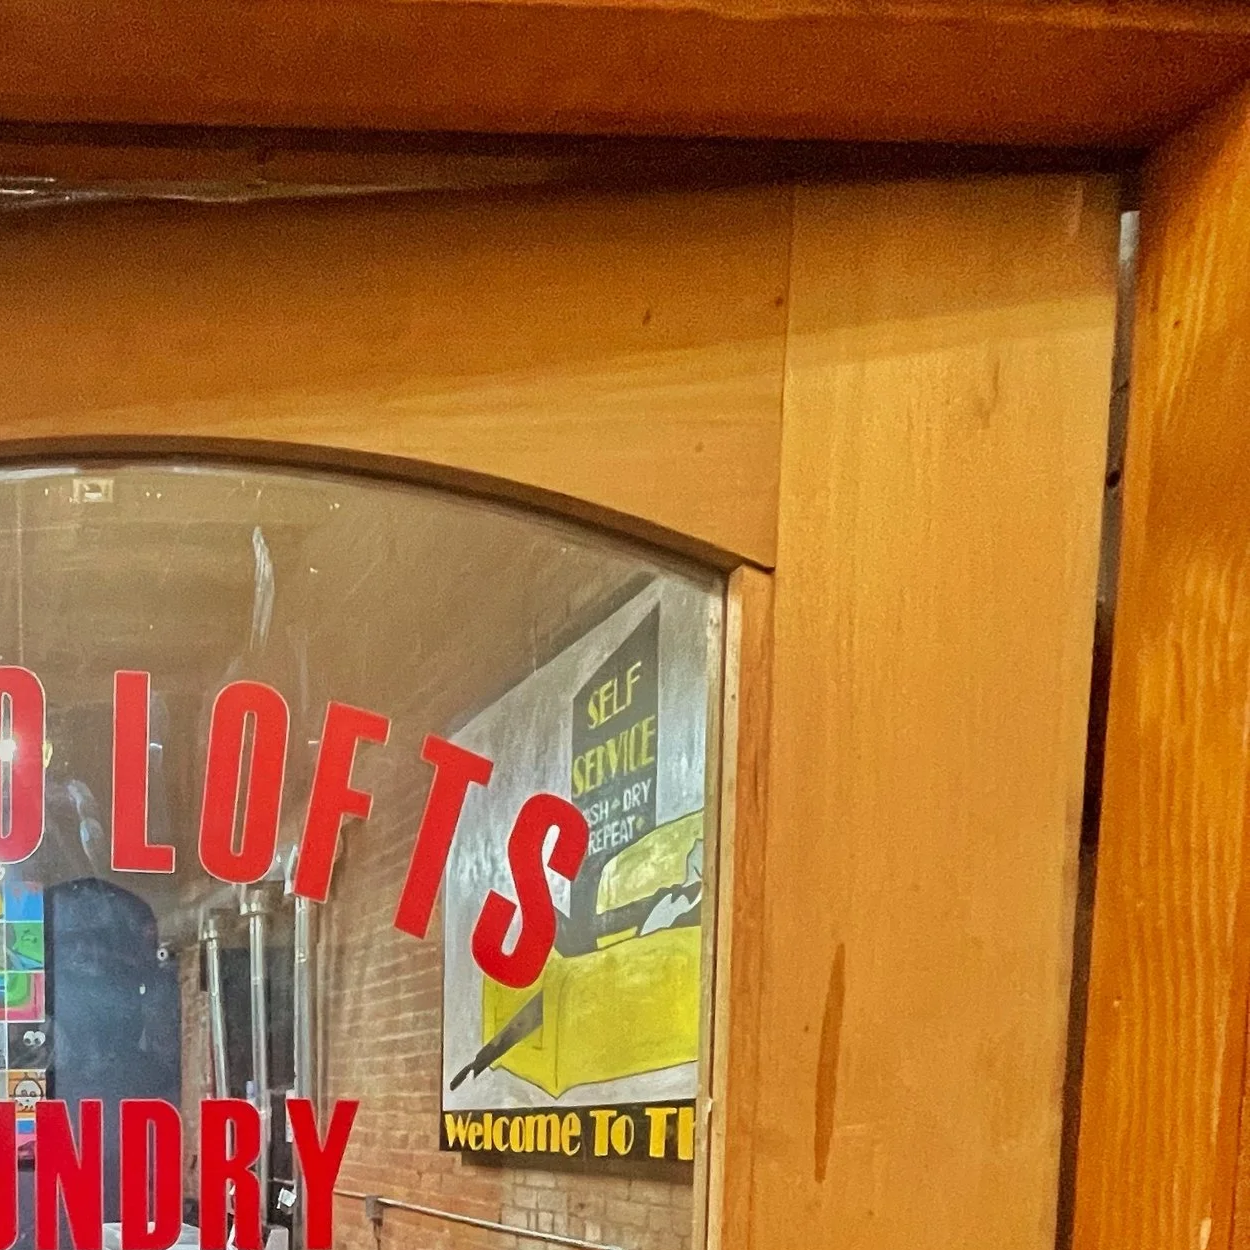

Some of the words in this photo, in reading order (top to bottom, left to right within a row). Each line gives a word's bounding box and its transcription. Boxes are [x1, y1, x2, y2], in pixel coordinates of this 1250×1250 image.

[587, 660, 642, 730] SELF
[571, 714, 656, 798] SERVICE
[622, 777, 652, 812] DRY
[110, 669, 590, 989] LOFTS
[588, 815, 636, 856] REPEAT
[444, 1111, 582, 1157] Welcome
[589, 1109, 635, 1157] To
